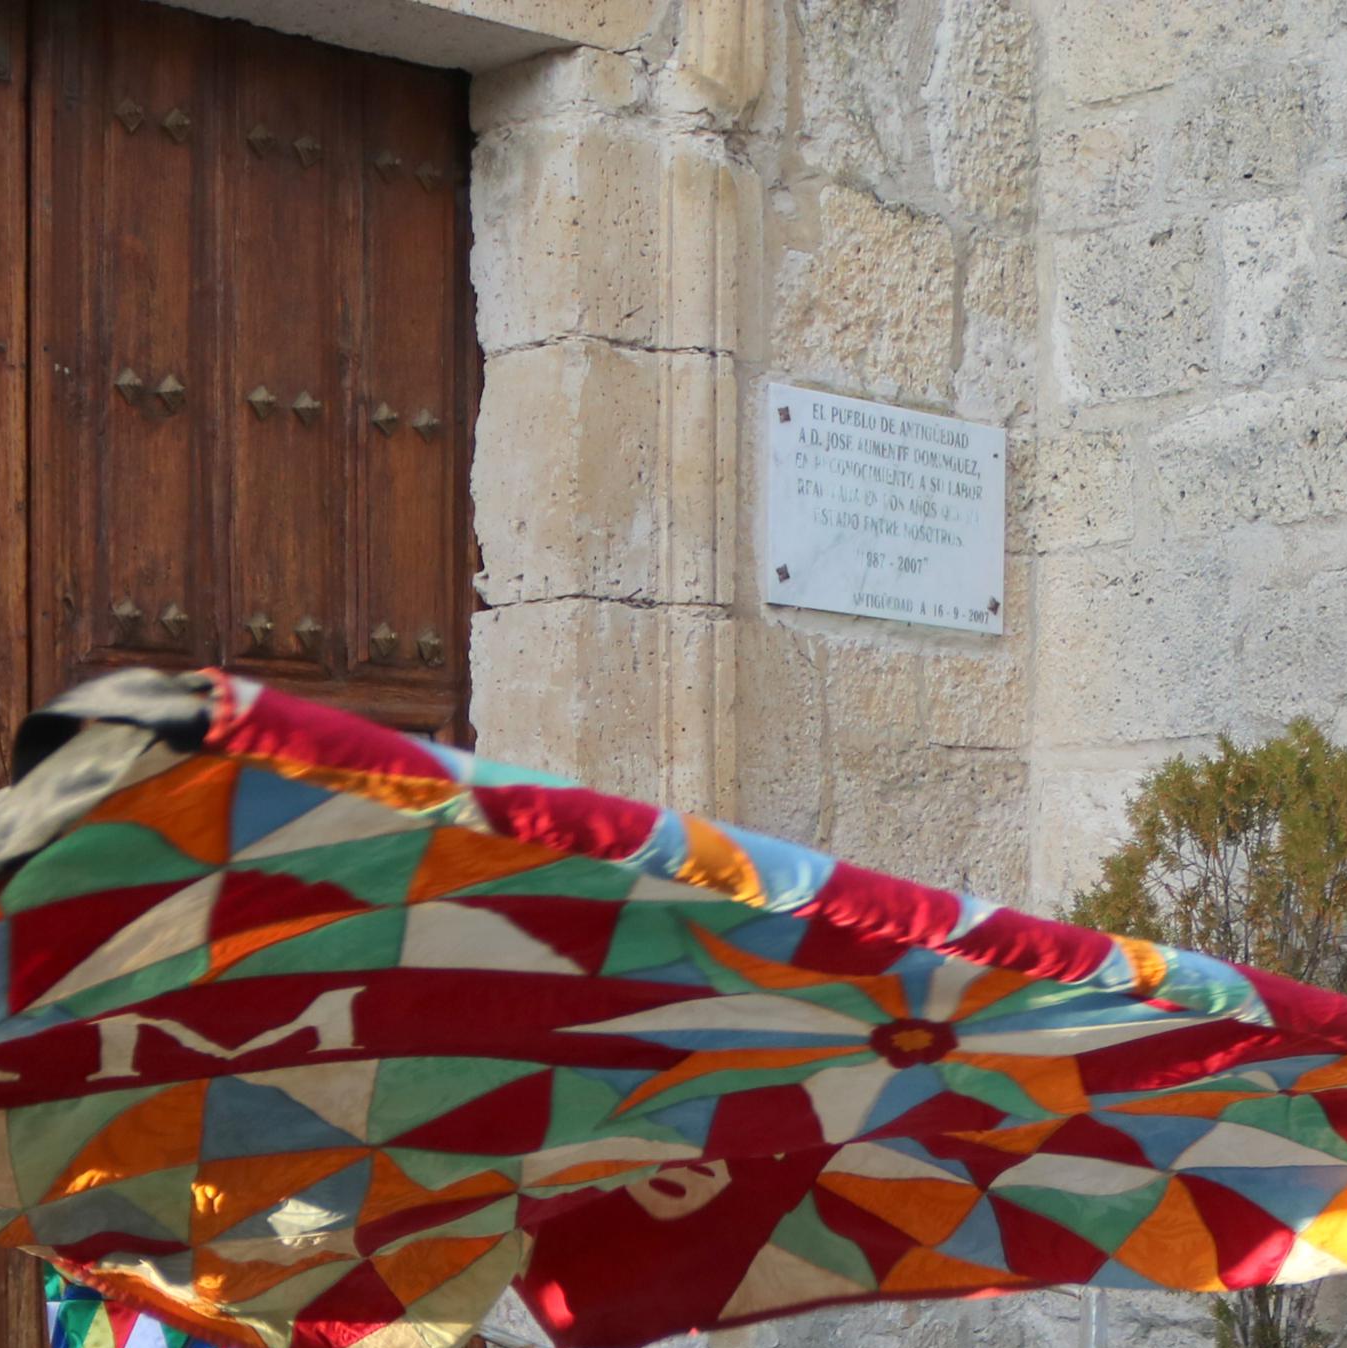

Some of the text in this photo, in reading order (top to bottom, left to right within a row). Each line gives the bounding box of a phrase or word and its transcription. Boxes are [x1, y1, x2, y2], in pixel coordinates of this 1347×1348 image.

[812, 401, 826, 421] EL
[830, 405, 876, 431] PUEBLO
[880, 415, 895, 435] DE
[798, 424, 806, 443] A
[810, 427, 822, 446] D.
[795, 450, 808, 470] EN
[918, 473, 926, 491] A
[947, 479, 983, 502] LABOR
[797, 476, 860, 506] REALADA
[919, 599, 926, 616] A
